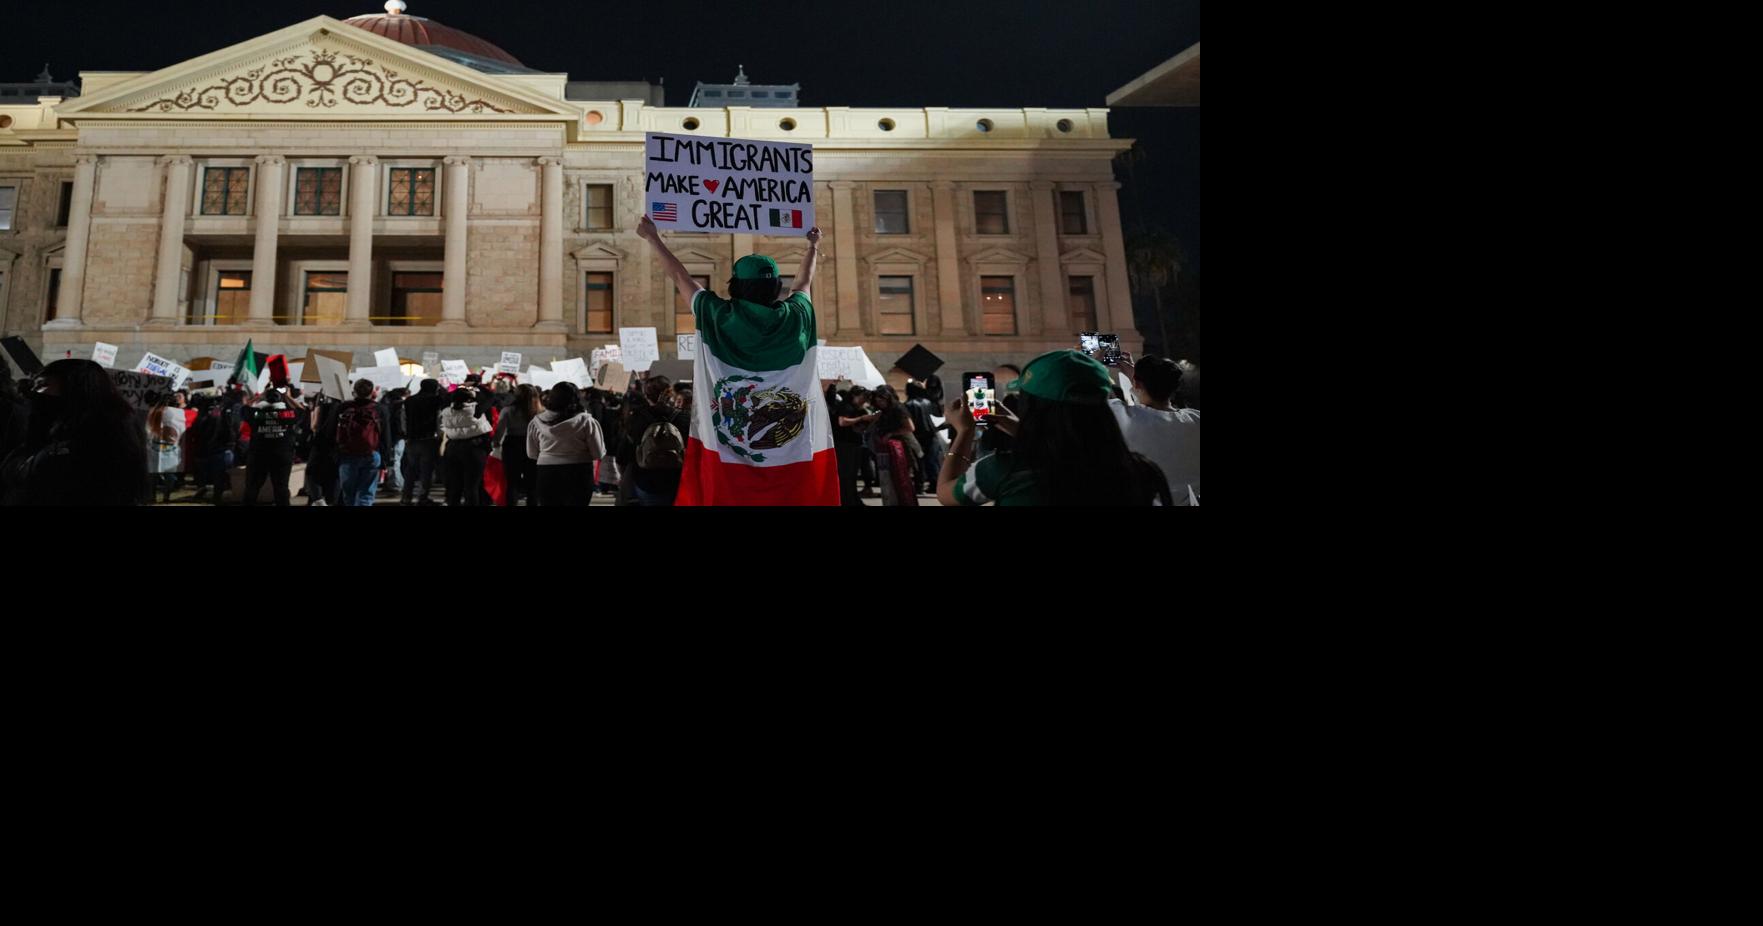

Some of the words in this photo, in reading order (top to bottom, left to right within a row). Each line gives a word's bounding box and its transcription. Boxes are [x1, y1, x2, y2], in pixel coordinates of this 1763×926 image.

[649, 136, 813, 173] IMMIGRANTS
[646, 172, 699, 195] MAKE
[722, 176, 811, 203] AMERICA
[692, 199, 762, 230] GREAT
[679, 336, 694, 352] RE
